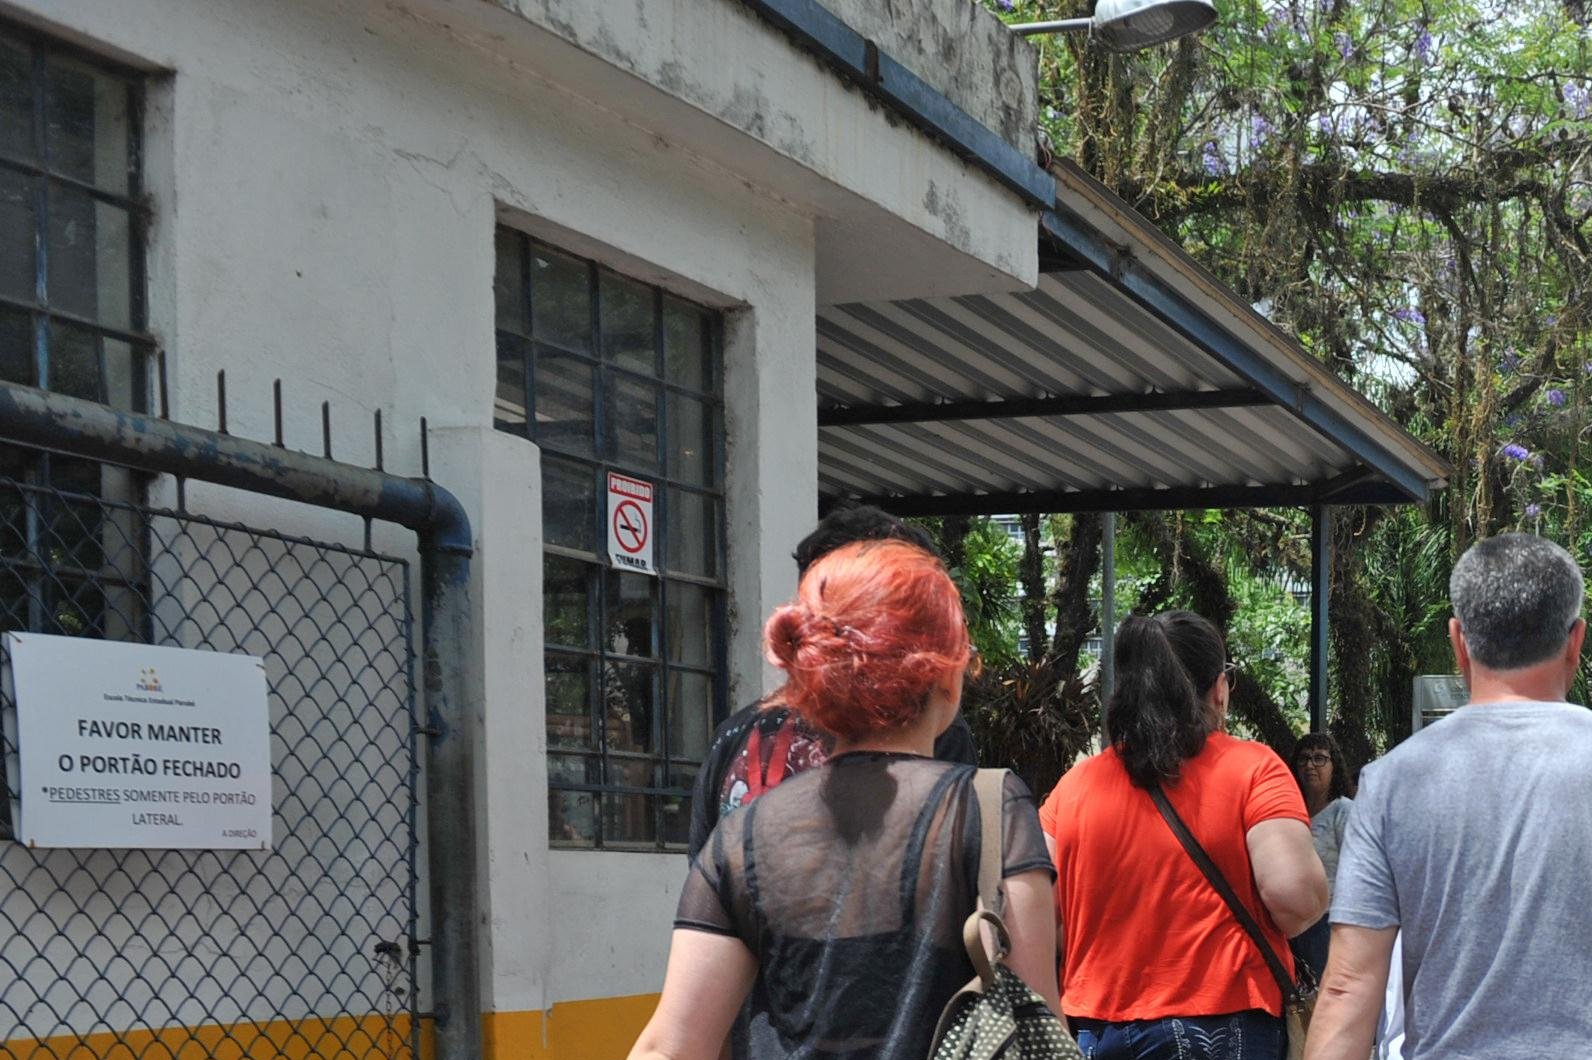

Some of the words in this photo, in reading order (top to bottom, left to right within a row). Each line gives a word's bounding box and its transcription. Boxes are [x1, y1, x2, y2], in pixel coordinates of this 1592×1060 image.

[78, 719, 143, 740] FAVOR
[148, 724, 223, 745] MANTER
[58, 754, 74, 772] O
[80, 754, 158, 776] PORTÃO
[163, 759, 241, 779] FECHADO
[123, 788, 180, 804] SOMENTE
[182, 792, 211, 805] PELO
[212, 792, 257, 806] PORTÃO
